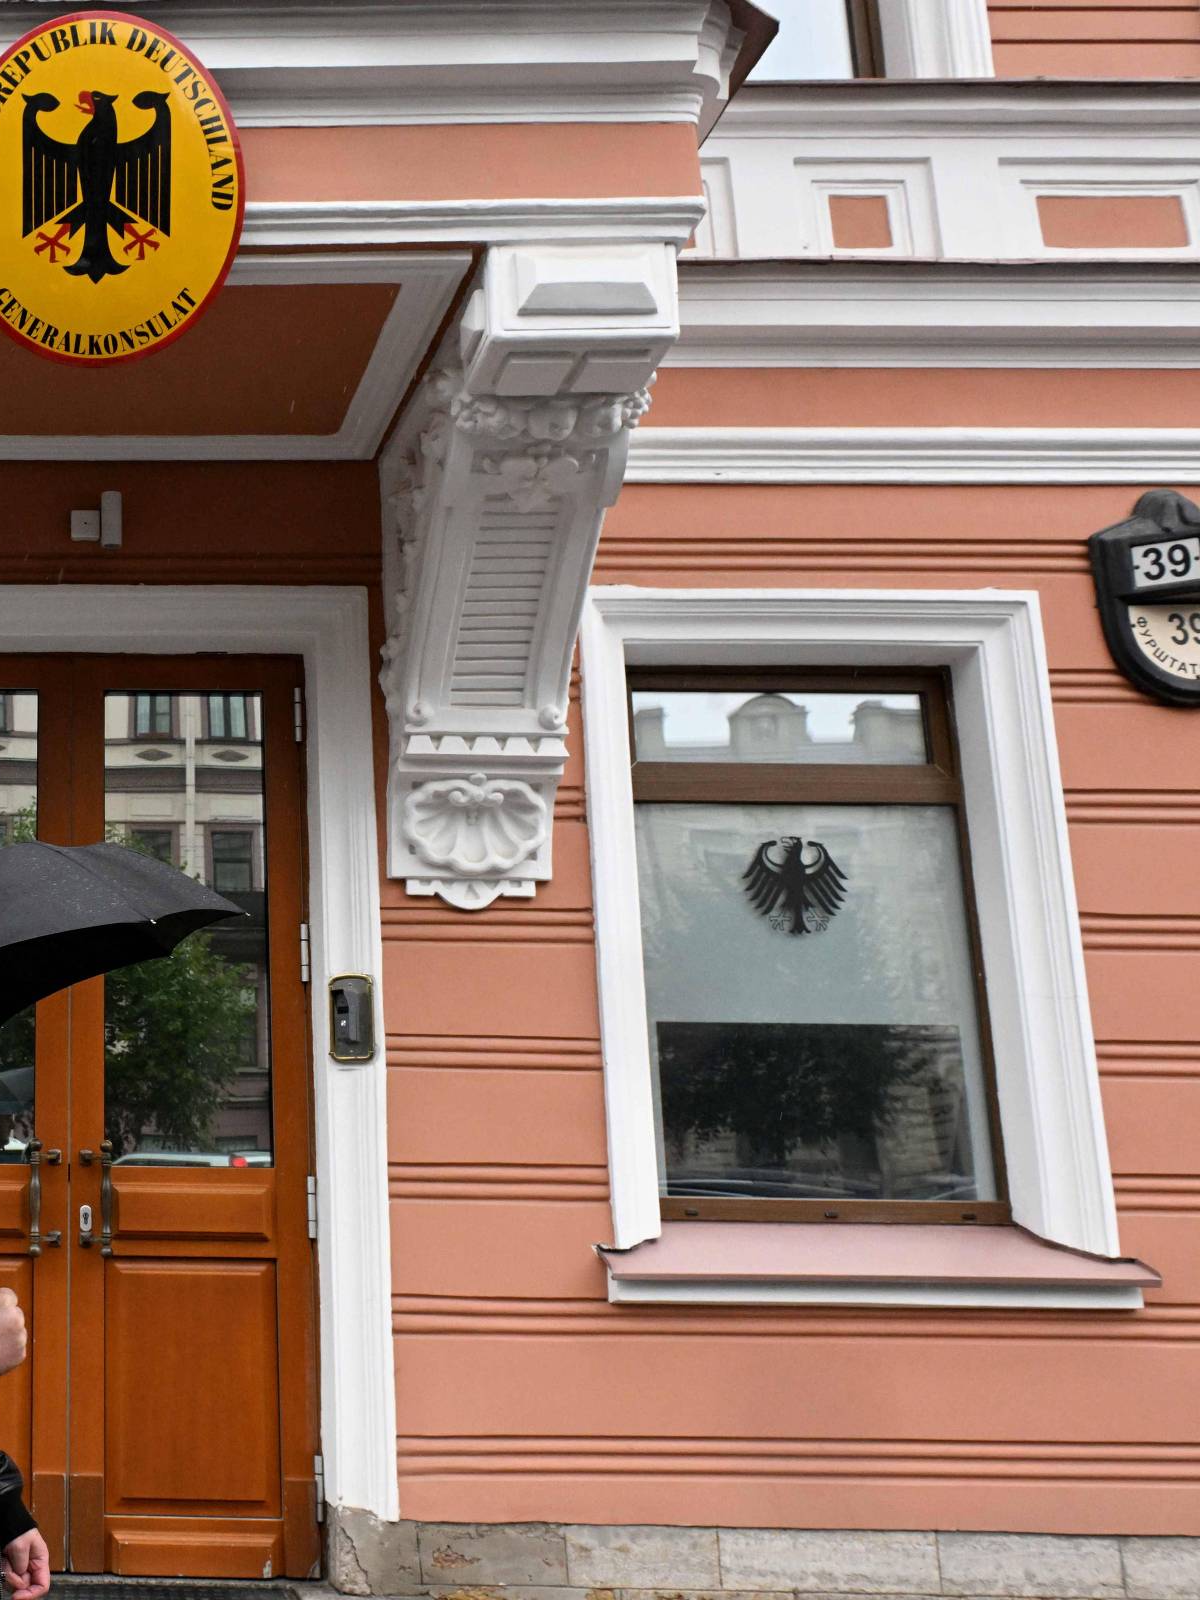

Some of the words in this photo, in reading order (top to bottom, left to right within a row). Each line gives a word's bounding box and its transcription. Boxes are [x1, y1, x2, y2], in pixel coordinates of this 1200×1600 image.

[126, 28, 235, 212] DEUTSCHLAND
[1141, 543, 1192, 581] 39
[1136, 616, 1200, 674] ФУРШТАТ
